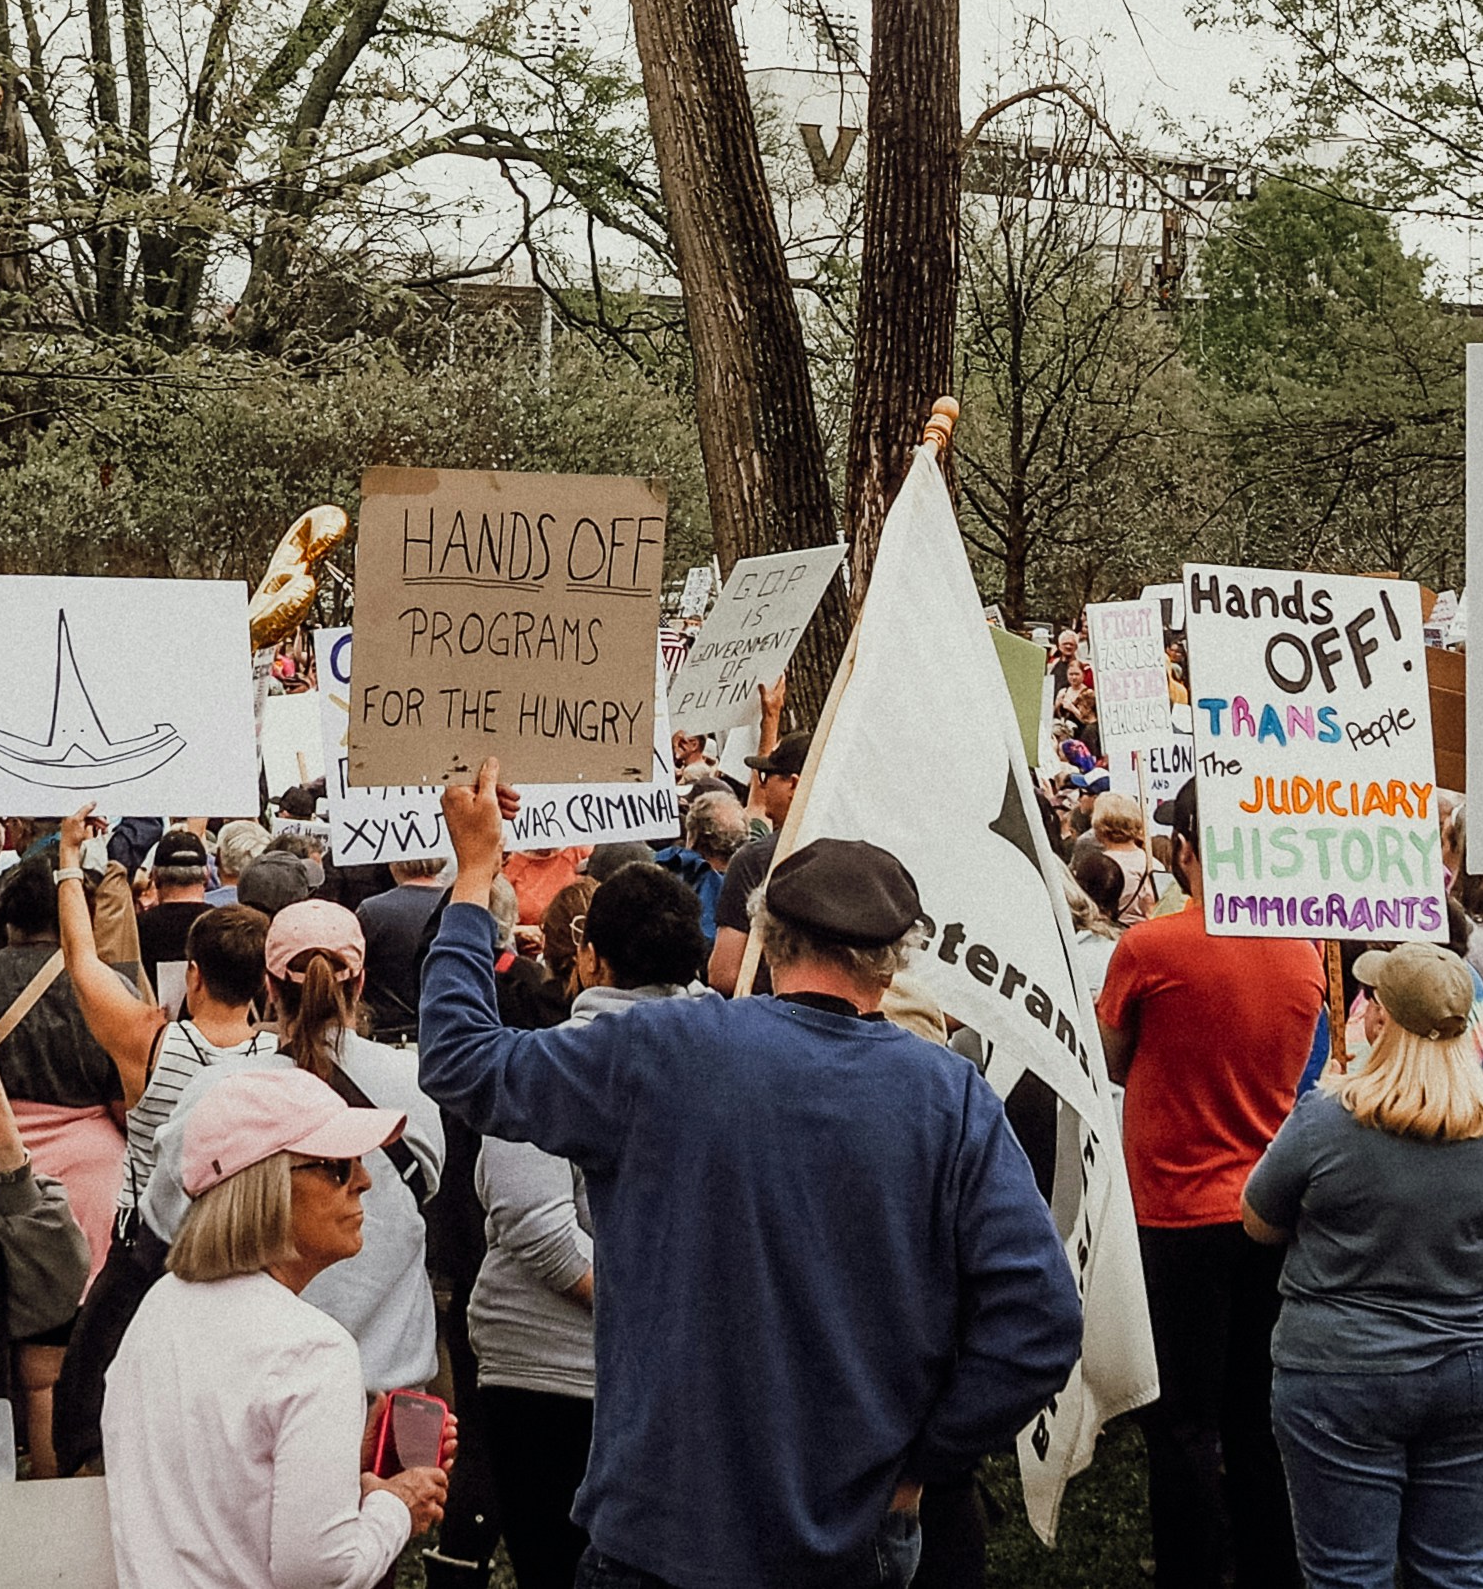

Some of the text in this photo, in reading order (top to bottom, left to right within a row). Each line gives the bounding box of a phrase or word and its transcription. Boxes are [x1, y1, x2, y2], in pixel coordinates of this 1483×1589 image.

[798, 123, 863, 184] V
[403, 508, 665, 588] HANDS OFF
[741, 604, 770, 629] IS
[1190, 572, 1334, 625] Hands
[399, 608, 603, 665] PROGRAMS
[692, 626, 800, 663] GOVERNMENT
[1265, 590, 1412, 694] OFF!
[719, 657, 752, 680] OF
[363, 685, 644, 745] FOR THE HUNGRY
[673, 675, 757, 715] PUTIN
[1197, 695, 1343, 747] TRANS
[1150, 744, 1193, 774] ELON
[1198, 751, 1243, 777] The
[1151, 779, 1170, 791] AND
[1239, 774, 1433, 819] JUDICIARY
[511, 788, 679, 841] WAR CRIMINAL
[1206, 824, 1440, 886] HISTORY
[1214, 893, 1442, 932] IMMIGRANTS
